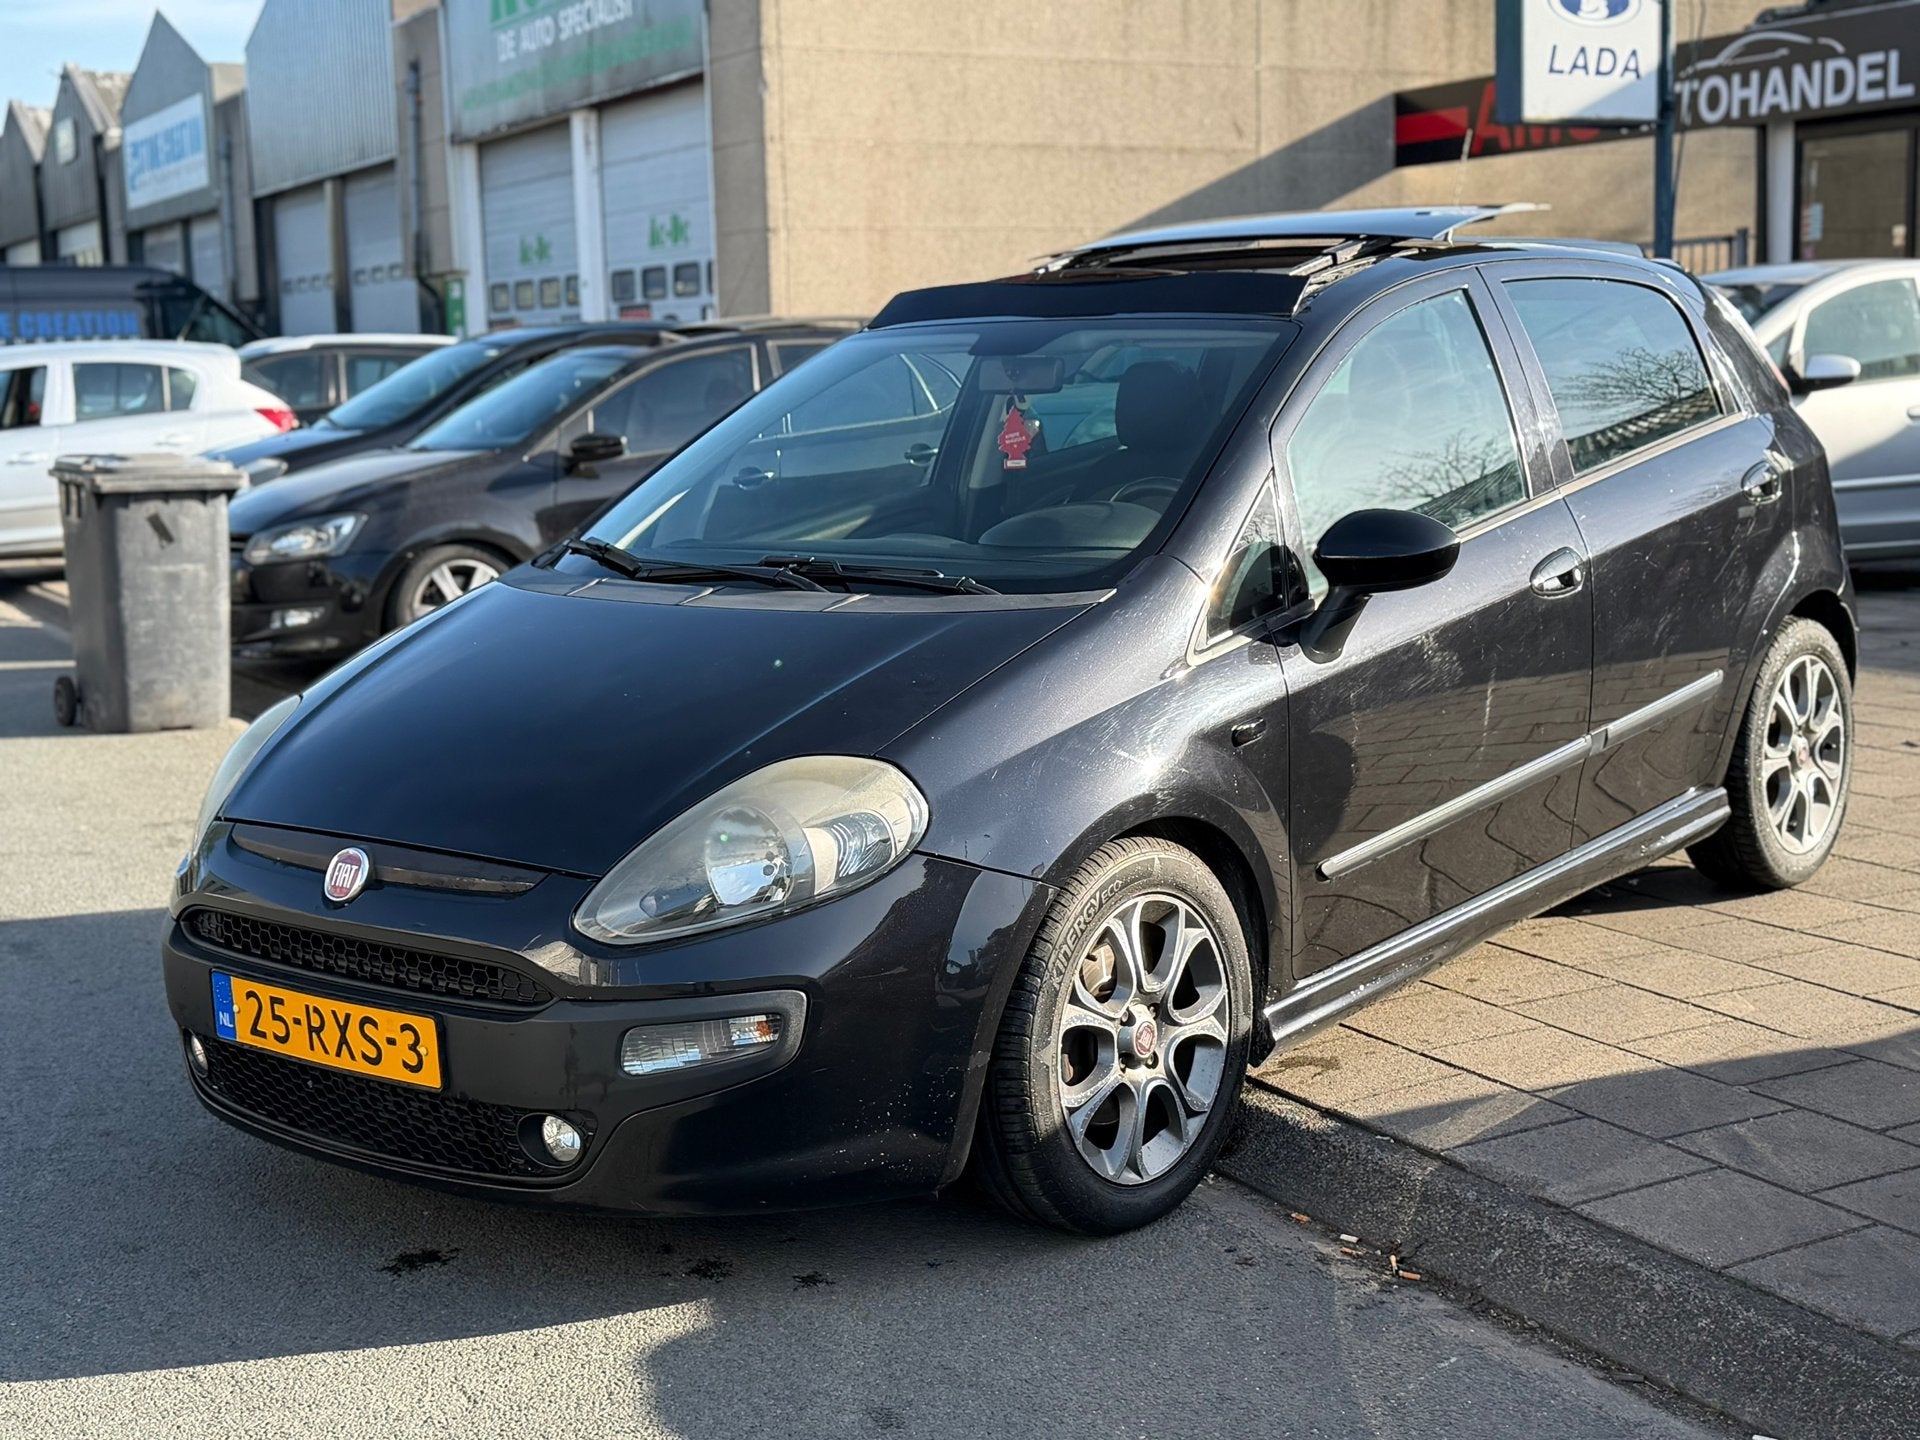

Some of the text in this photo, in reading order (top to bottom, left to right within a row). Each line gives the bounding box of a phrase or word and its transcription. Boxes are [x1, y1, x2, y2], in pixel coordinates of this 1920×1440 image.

[497, 29, 517, 63] DE
[519, 16, 556, 52] AUTO
[1548, 44, 1640, 80] LADA
[1673, 48, 1916, 127] TOHANDEL
[19, 310, 140, 338] CREATION
[331, 862, 359, 889] FIAT
[218, 1010, 234, 1028] NL
[245, 989, 425, 1074] 25-RXS-3
